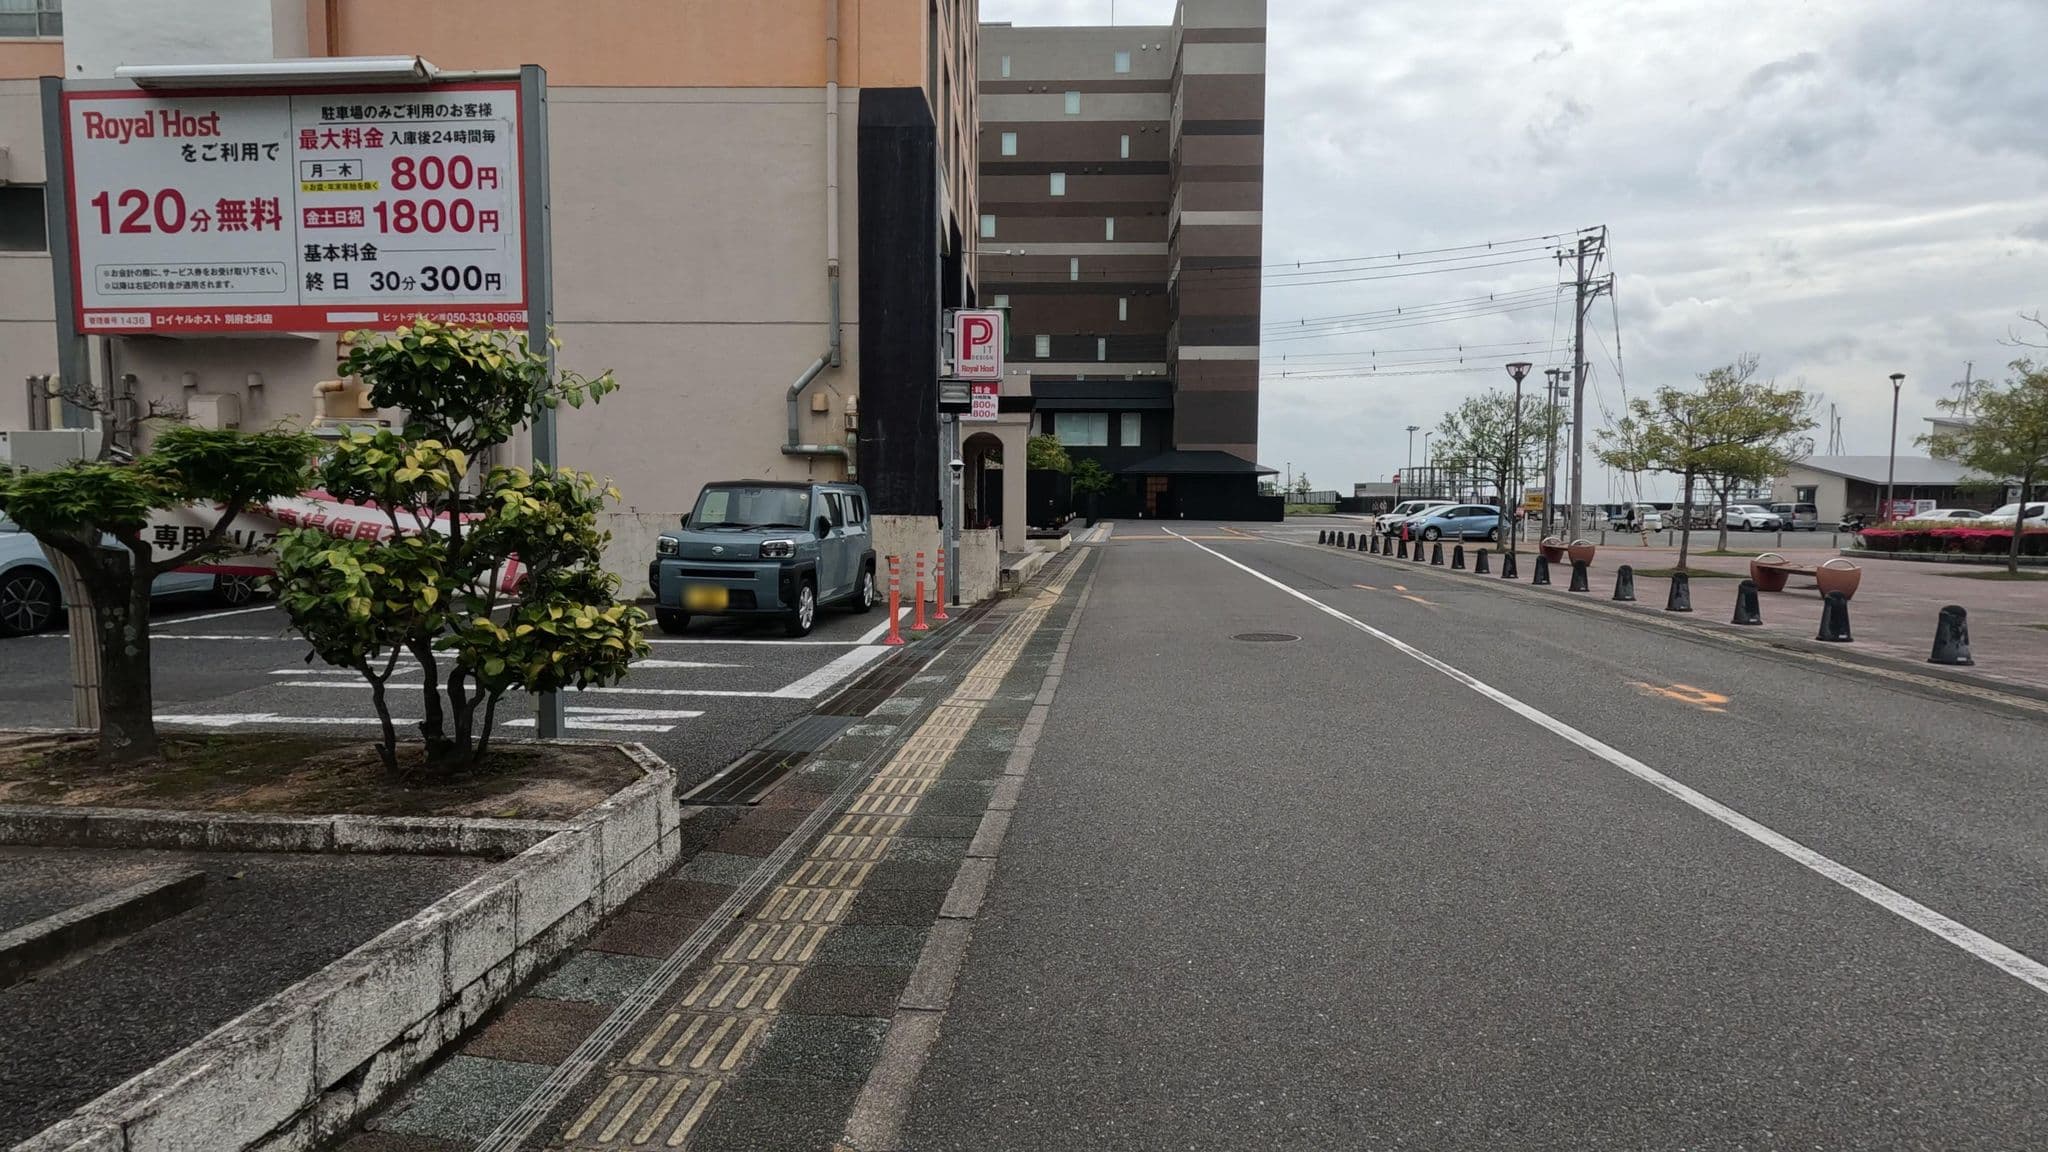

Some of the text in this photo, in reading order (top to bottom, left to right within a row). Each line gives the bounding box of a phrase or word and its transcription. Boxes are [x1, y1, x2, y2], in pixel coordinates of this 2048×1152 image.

[321, 103, 493, 121] 駐車場のみご利用のお客様
[82, 110, 221, 144] Royal Host
[299, 127, 496, 150] 最大料金 入庫後24時間毎
[181, 142, 280, 163] をご利用で
[391, 155, 498, 191] 800円
[91, 188, 283, 234] 120分無料
[305, 209, 363, 226] 金土日祝
[373, 198, 499, 234] 1800円
[304, 243, 378, 262] 基本料金
[156, 314, 222, 326] ロイヤルホスト
[961, 364, 995, 374] Royal Host
